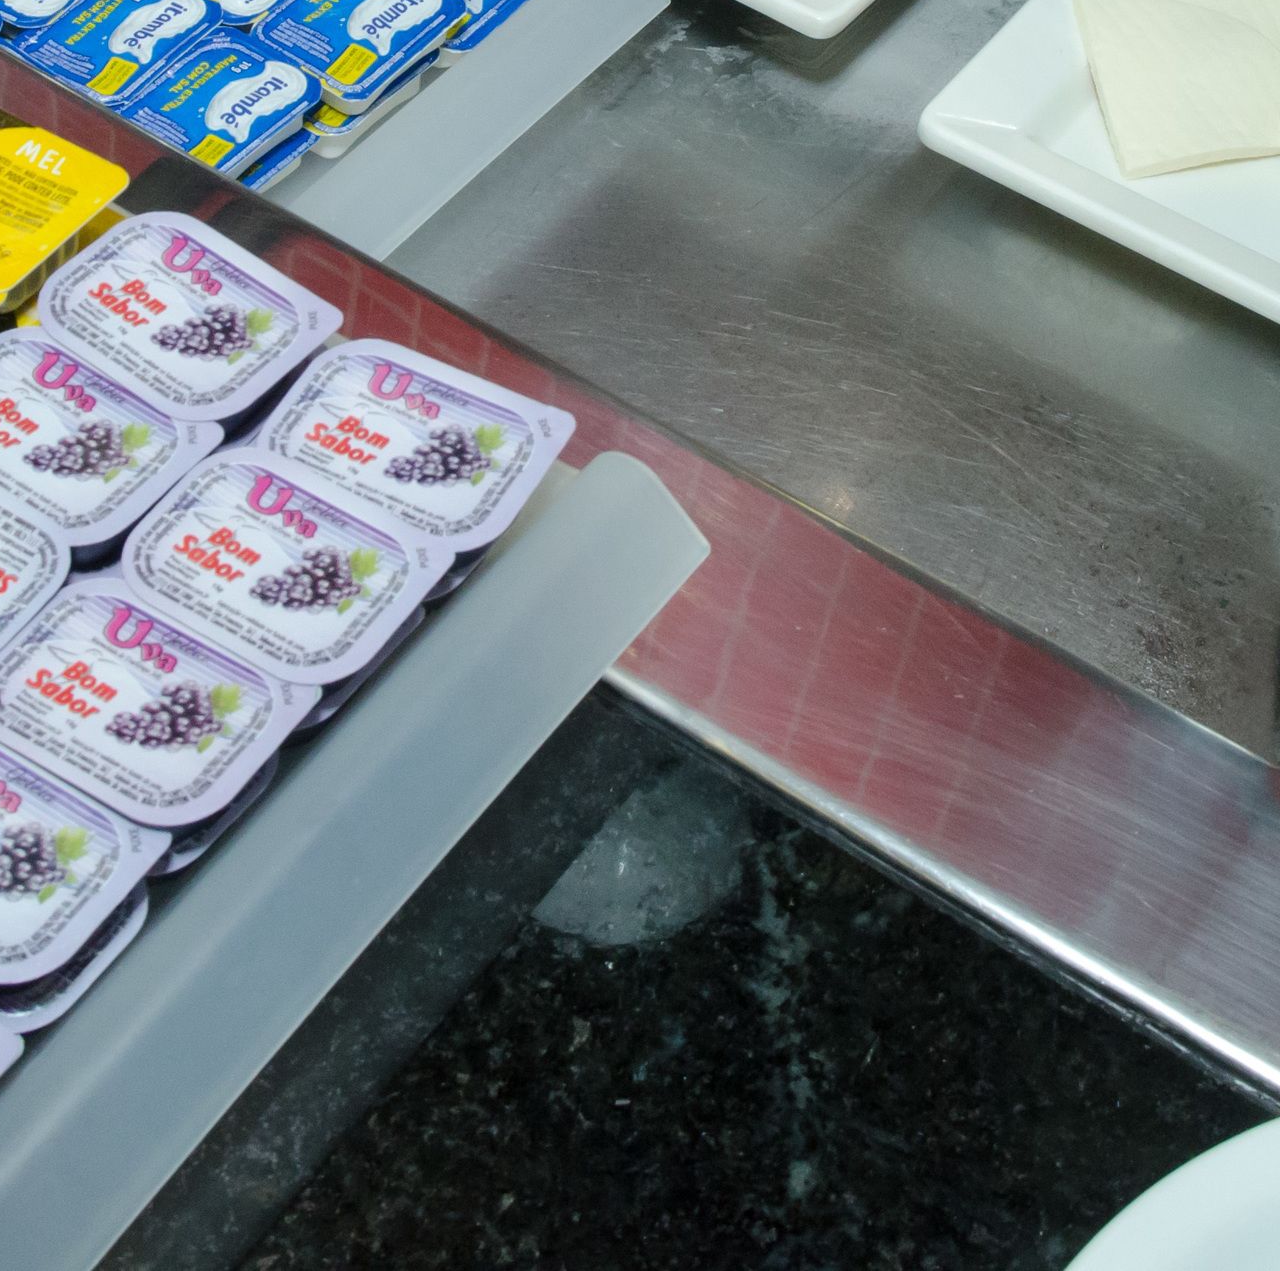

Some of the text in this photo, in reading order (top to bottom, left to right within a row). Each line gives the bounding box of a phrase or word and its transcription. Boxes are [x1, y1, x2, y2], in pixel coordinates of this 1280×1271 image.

[124, 1, 188, 49] itambé
[231, 61, 252, 73] 10g
[221, 77, 288, 128] itambé
[16, 140, 69, 176] MEL
[162, 237, 223, 296] Uva
[89, 283, 150, 327] Sabor
[122, 279, 168, 315] Bom
[32, 352, 96, 412] Uva
[368, 364, 440, 419] Uva
[305, 424, 377, 464] Sabor
[336, 416, 390, 449] Bom
[246, 474, 318, 538] Uva
[173, 535, 245, 583] Sabor
[208, 527, 261, 566] Bom
[104, 606, 177, 673] Uva
[26, 669, 101, 718] Sabor
[64, 661, 118, 702] Bom
